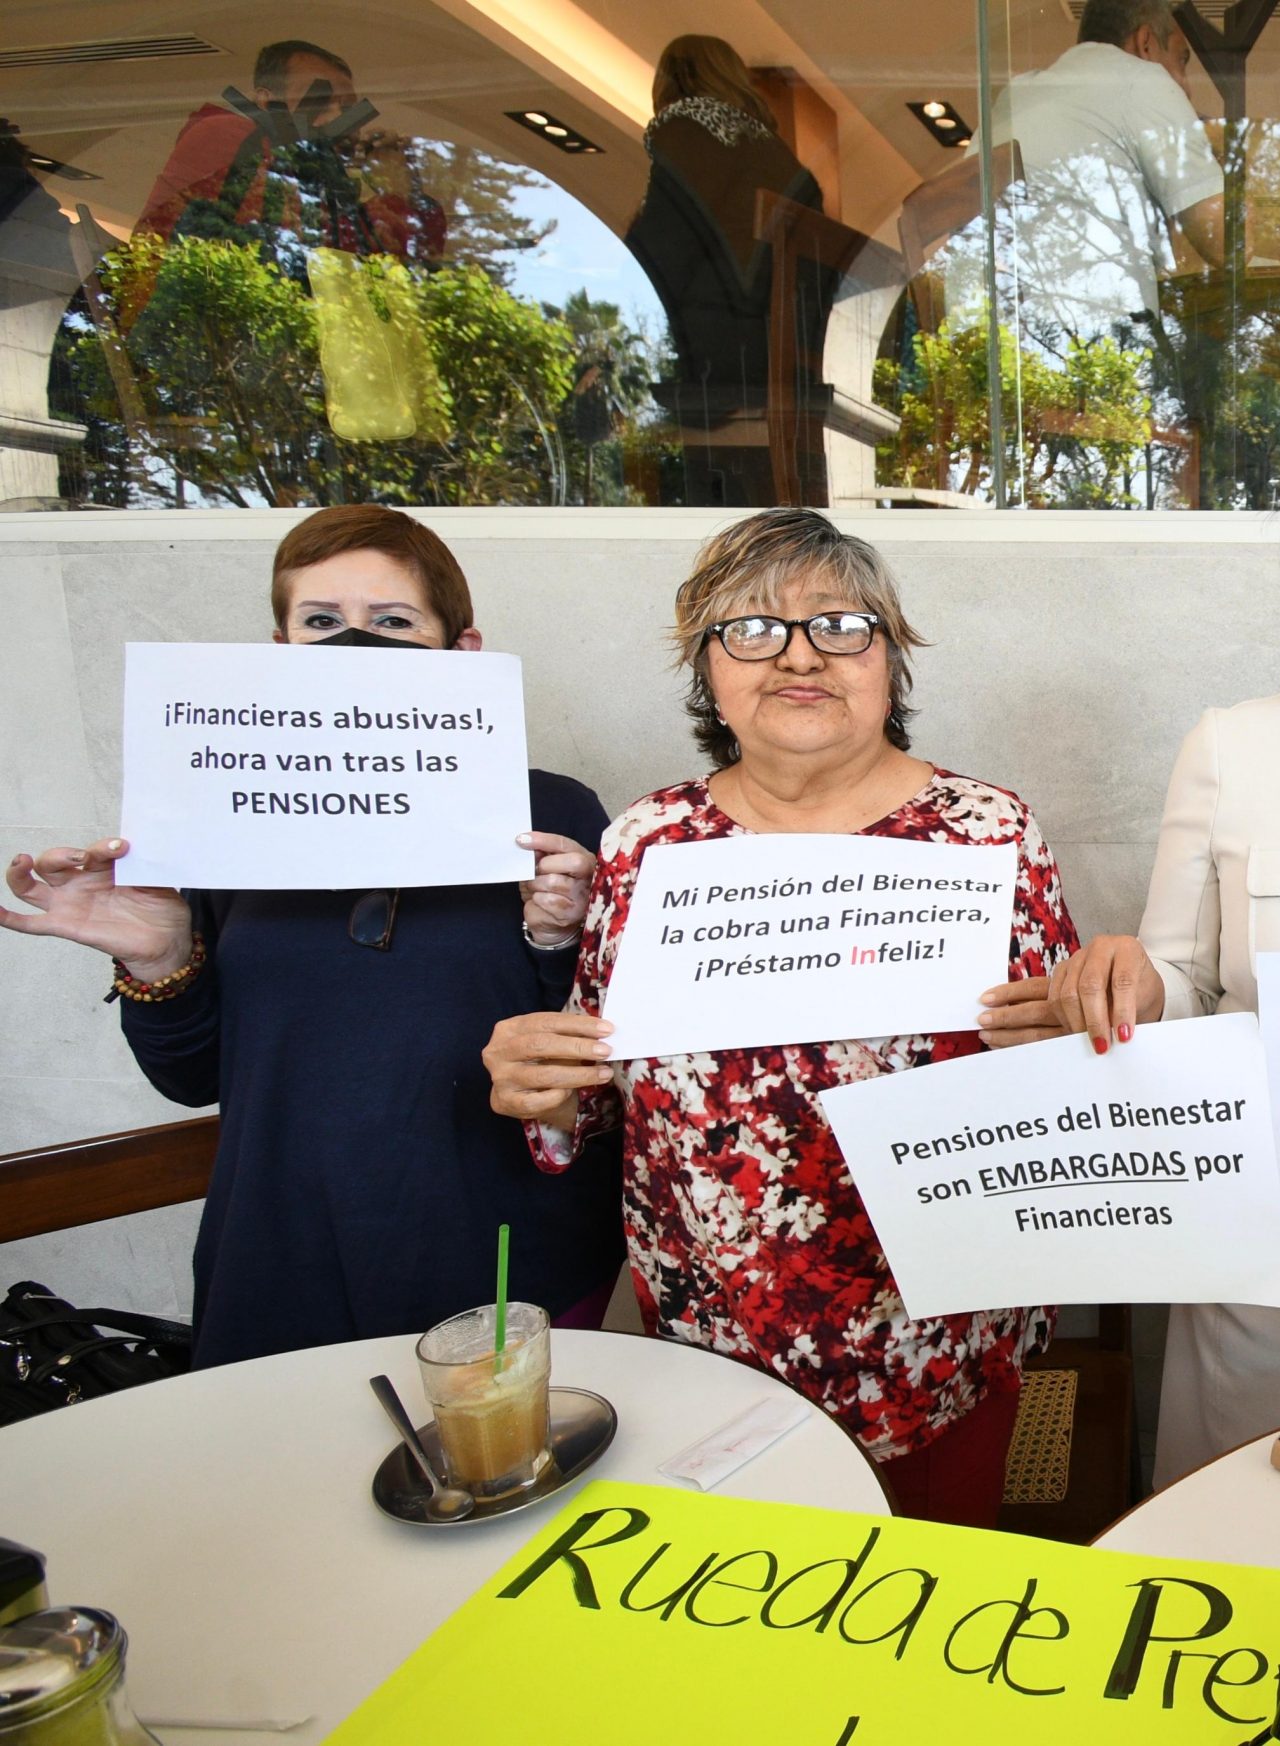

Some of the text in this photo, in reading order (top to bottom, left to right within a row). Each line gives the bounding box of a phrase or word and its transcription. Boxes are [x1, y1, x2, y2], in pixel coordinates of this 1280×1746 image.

[165, 701, 494, 735] ¡Financieras abusivas!,
[190, 745, 459, 773] ahora van tras las
[232, 791, 411, 815] PENSIONES
[662, 873, 1003, 909] Mi Pensión del Bienestar
[660, 904, 990, 945] la cobra una Financiera,
[694, 937, 945, 982] ¡Préstamo Infeliz!
[890, 1099, 1246, 1166] Pensiones del Bienestar
[917, 1150, 1244, 1204] son EMBARGADAS por
[1014, 1200, 1173, 1232] Financieras
[496, 1507, 939, 1661] Rueda
[943, 1578, 1070, 1696] de
